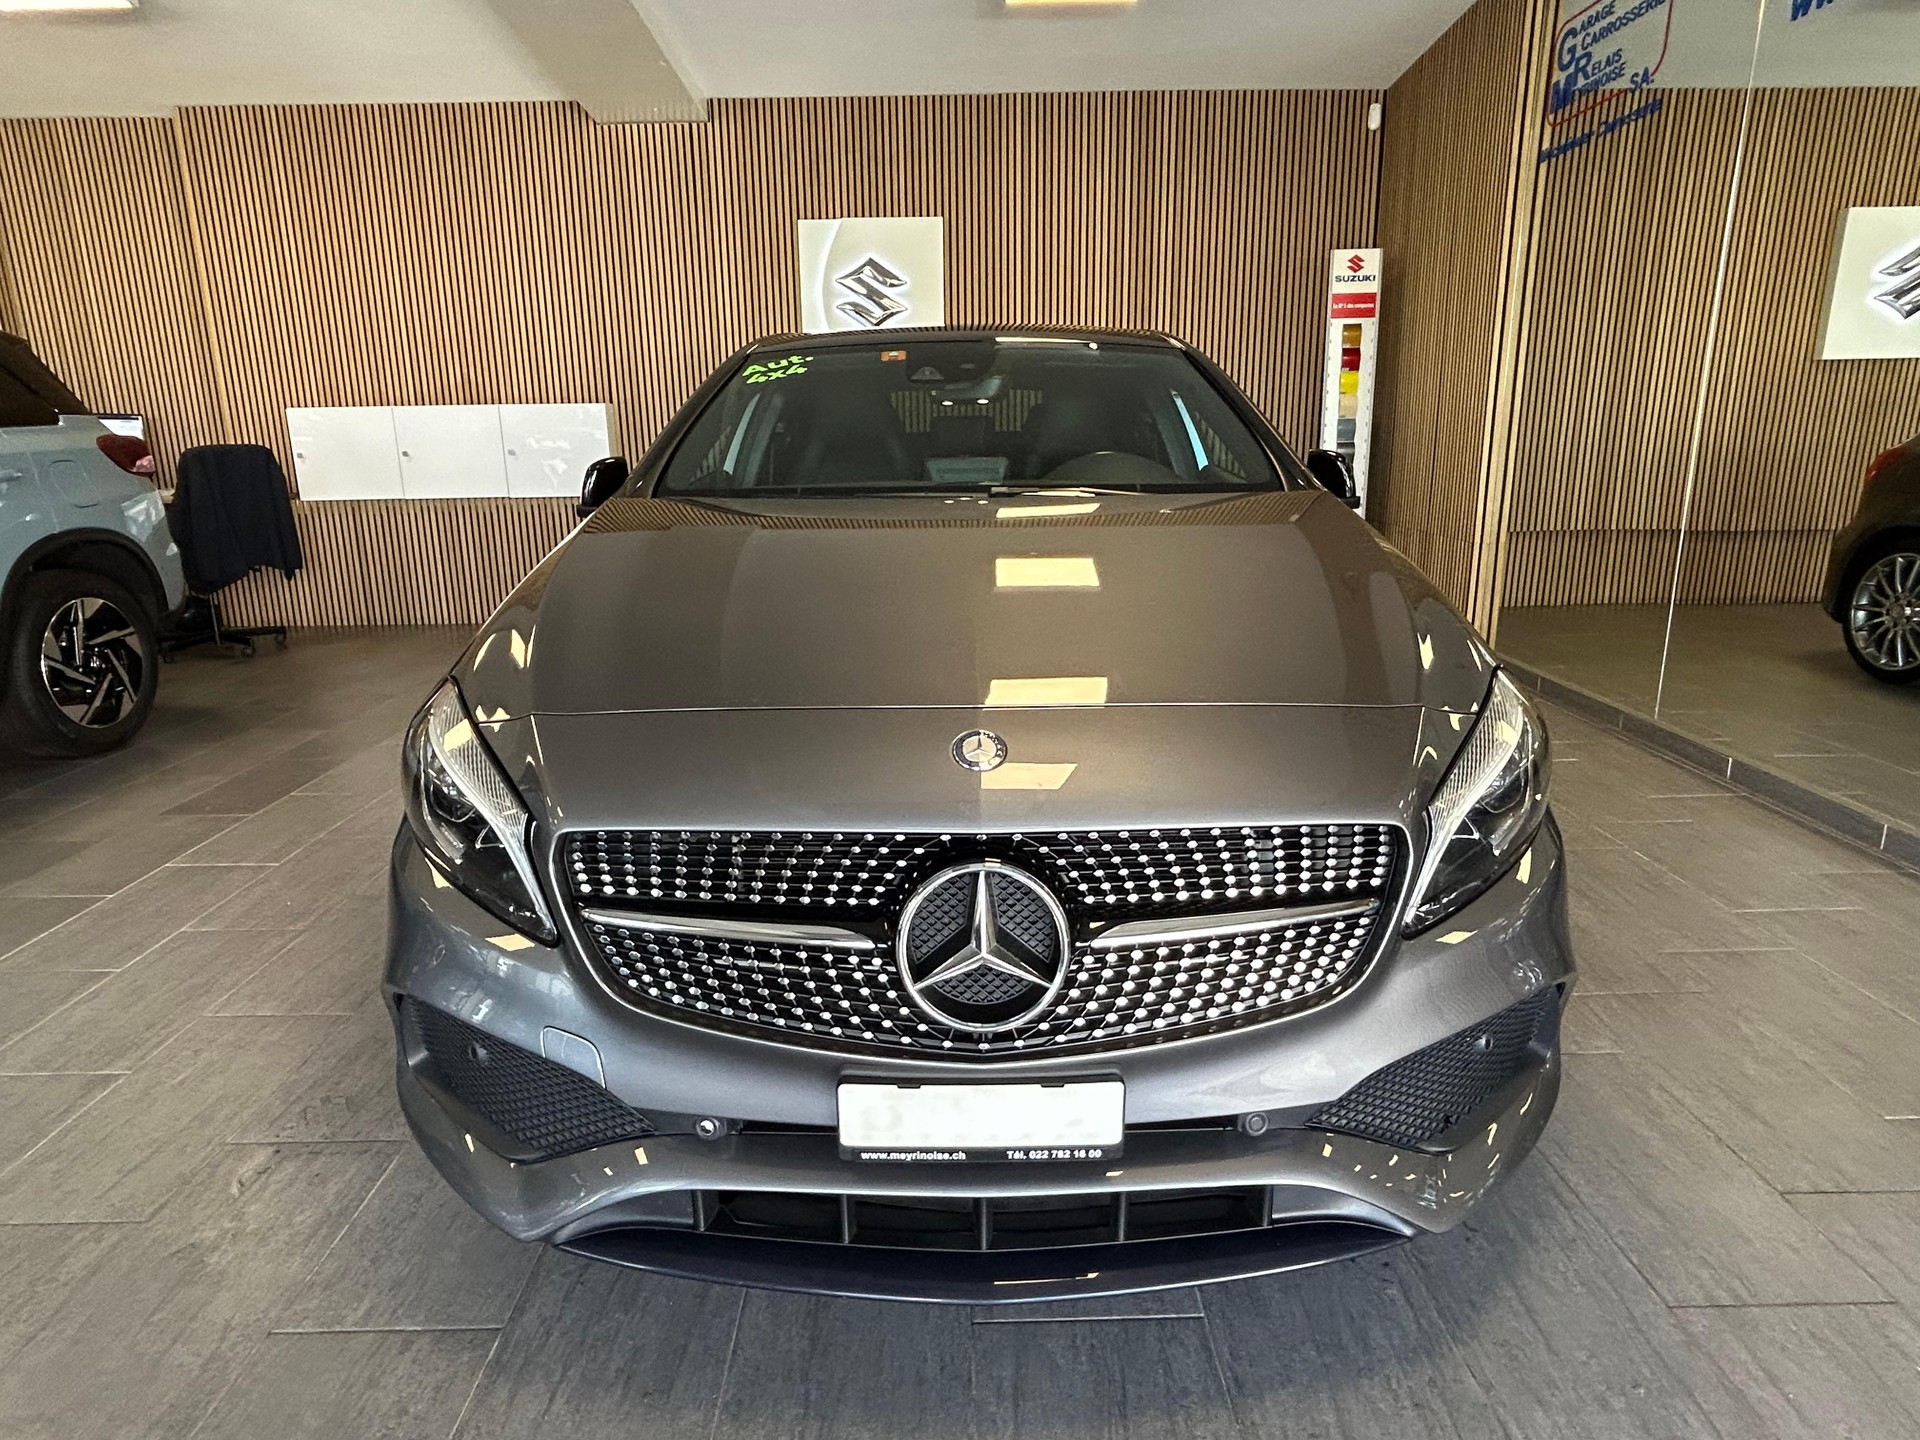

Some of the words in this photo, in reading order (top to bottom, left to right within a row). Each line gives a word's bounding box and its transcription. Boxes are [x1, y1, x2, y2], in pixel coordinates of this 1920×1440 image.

[1557, 0, 1617, 72] GARAGE
[1573, 47, 1623, 81] RELAIS
[1335, 274, 1376, 282] SUZUKI
[742, 355, 814, 377] Aut.
[746, 364, 808, 384] 4x4
[860, 1150, 967, 1161] www.meyrinoise.ch
[1029, 1150, 1049, 1160] 022
[1088, 1149, 1102, 1158] 00
